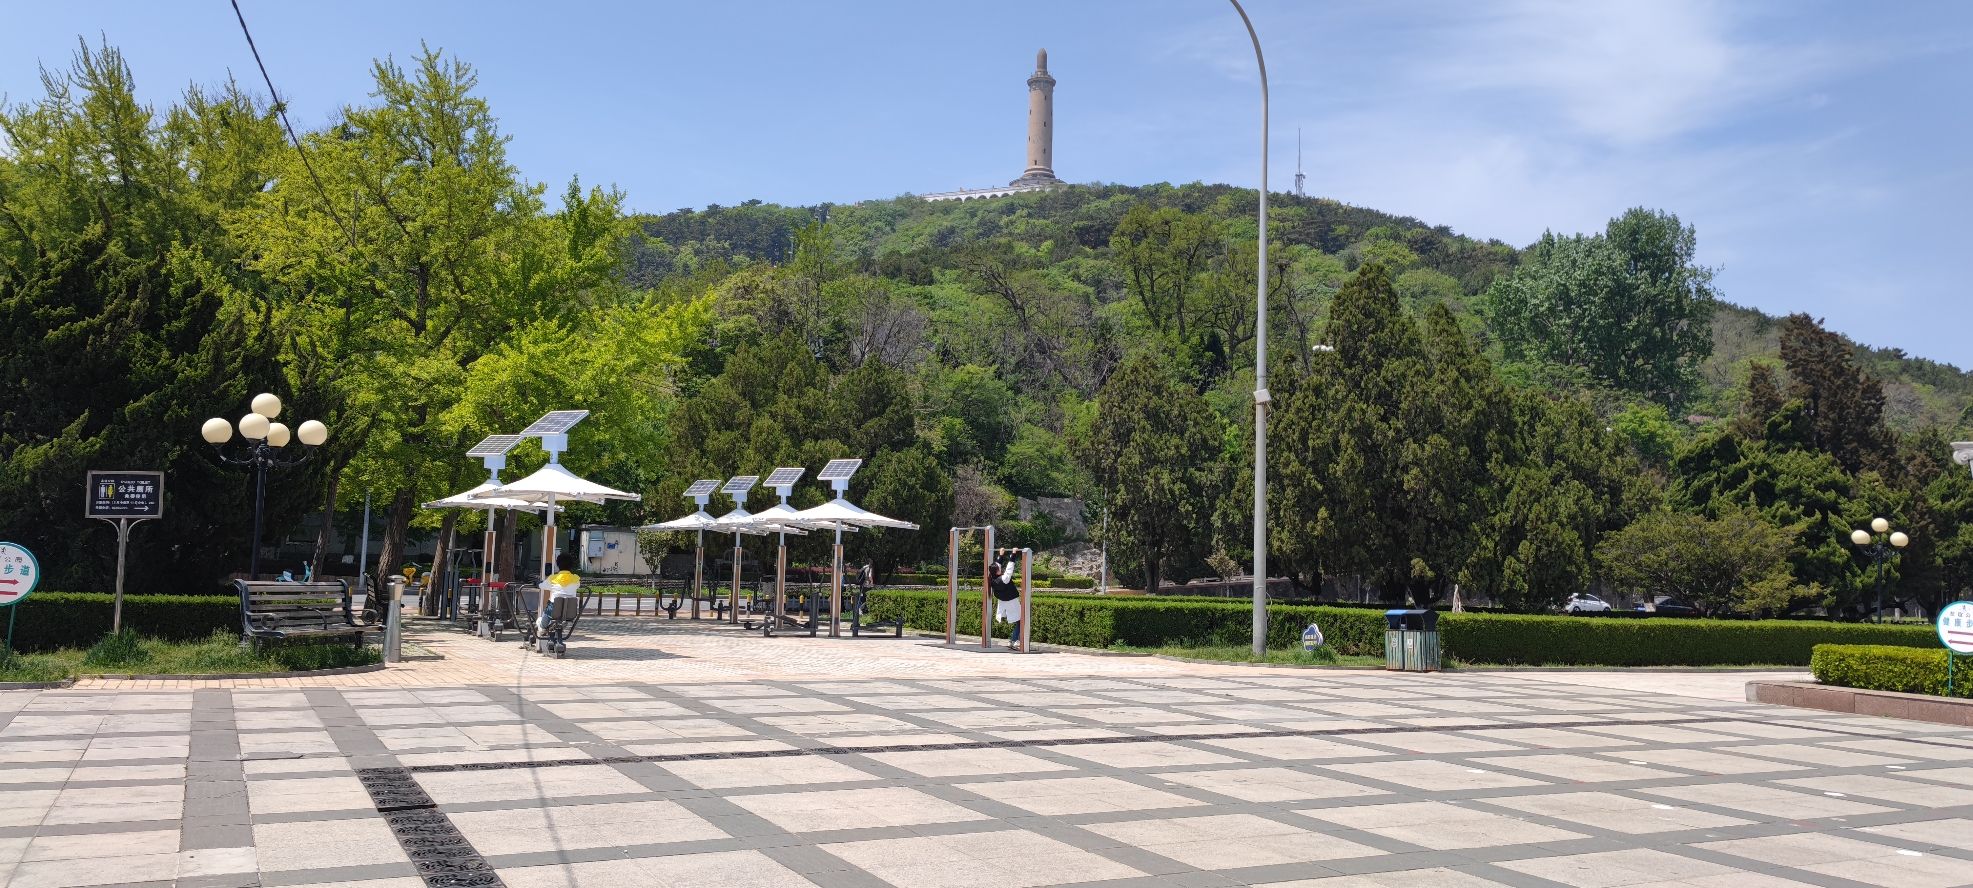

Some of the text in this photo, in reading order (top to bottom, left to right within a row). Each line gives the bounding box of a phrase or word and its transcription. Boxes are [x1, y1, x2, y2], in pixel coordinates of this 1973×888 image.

[118, 485, 154, 493] 公共厕所
[4, 564, 31, 576] 步道
